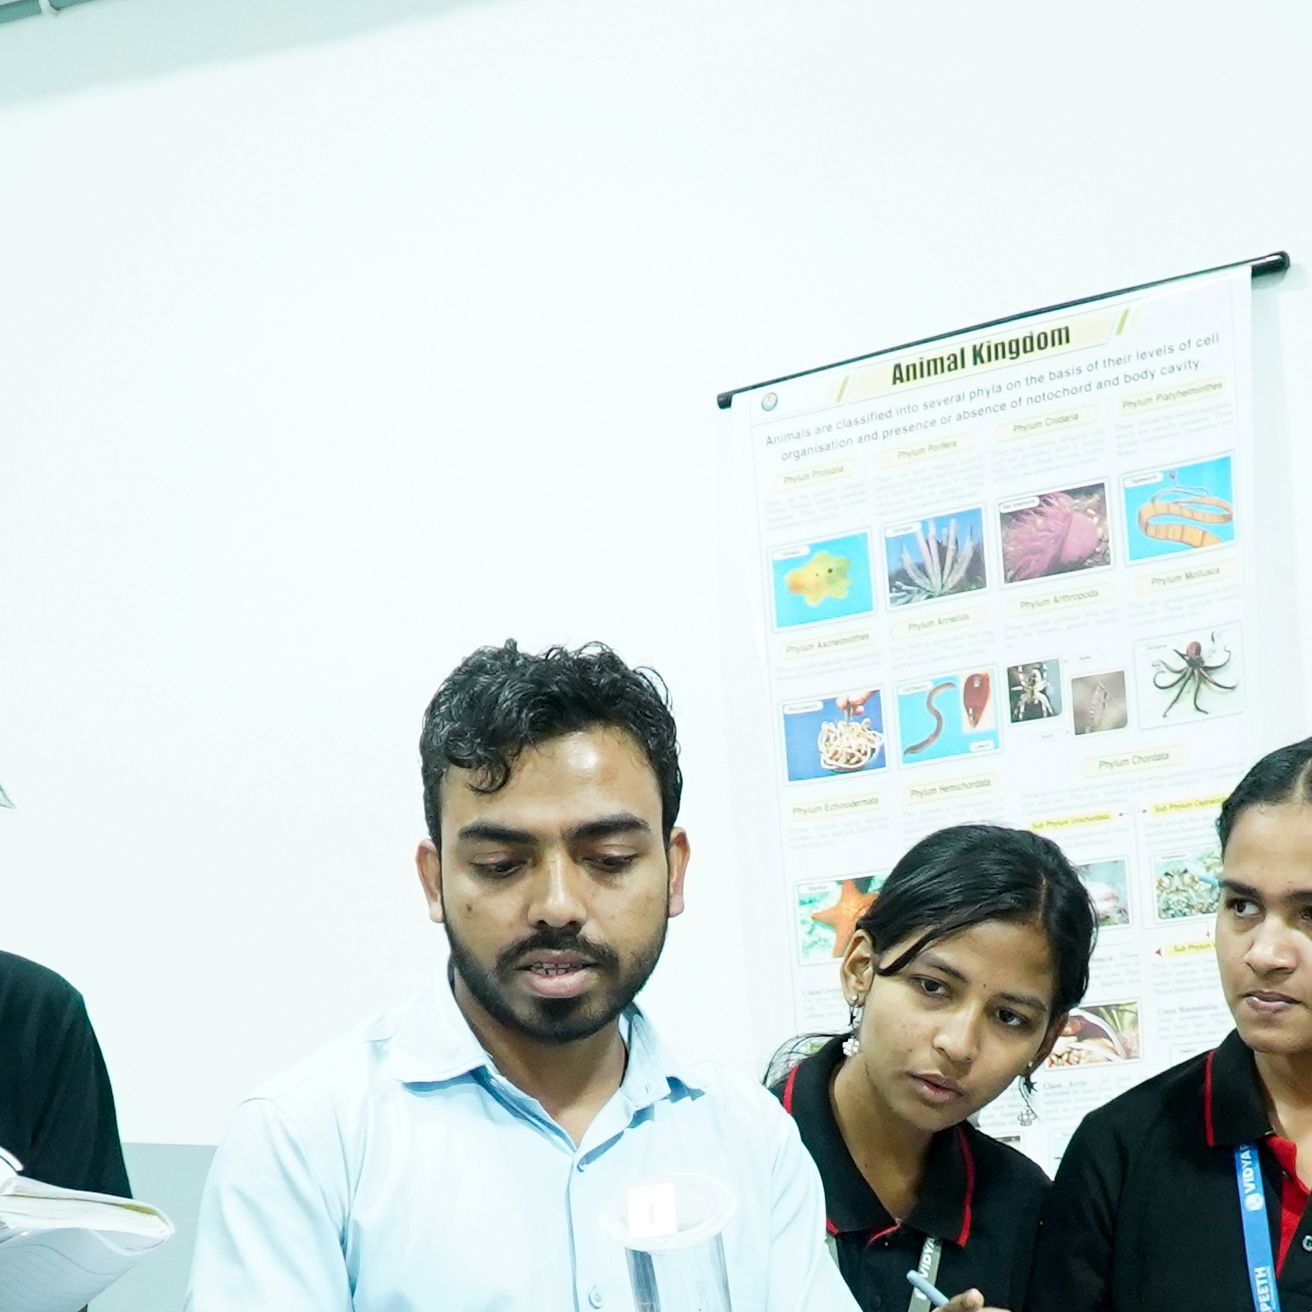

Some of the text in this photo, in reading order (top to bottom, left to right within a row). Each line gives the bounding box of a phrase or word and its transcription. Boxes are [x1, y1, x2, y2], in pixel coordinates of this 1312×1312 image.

[765, 333, 1219, 446] Animals are classified into several phyla on the basis of their levels of cell
[891, 326, 1071, 386] Animal Kingdom
[781, 360, 1204, 461] organisation and presence or absence of notochord and body cavity.
[1098, 752, 1169, 770] Phylum Chordata
